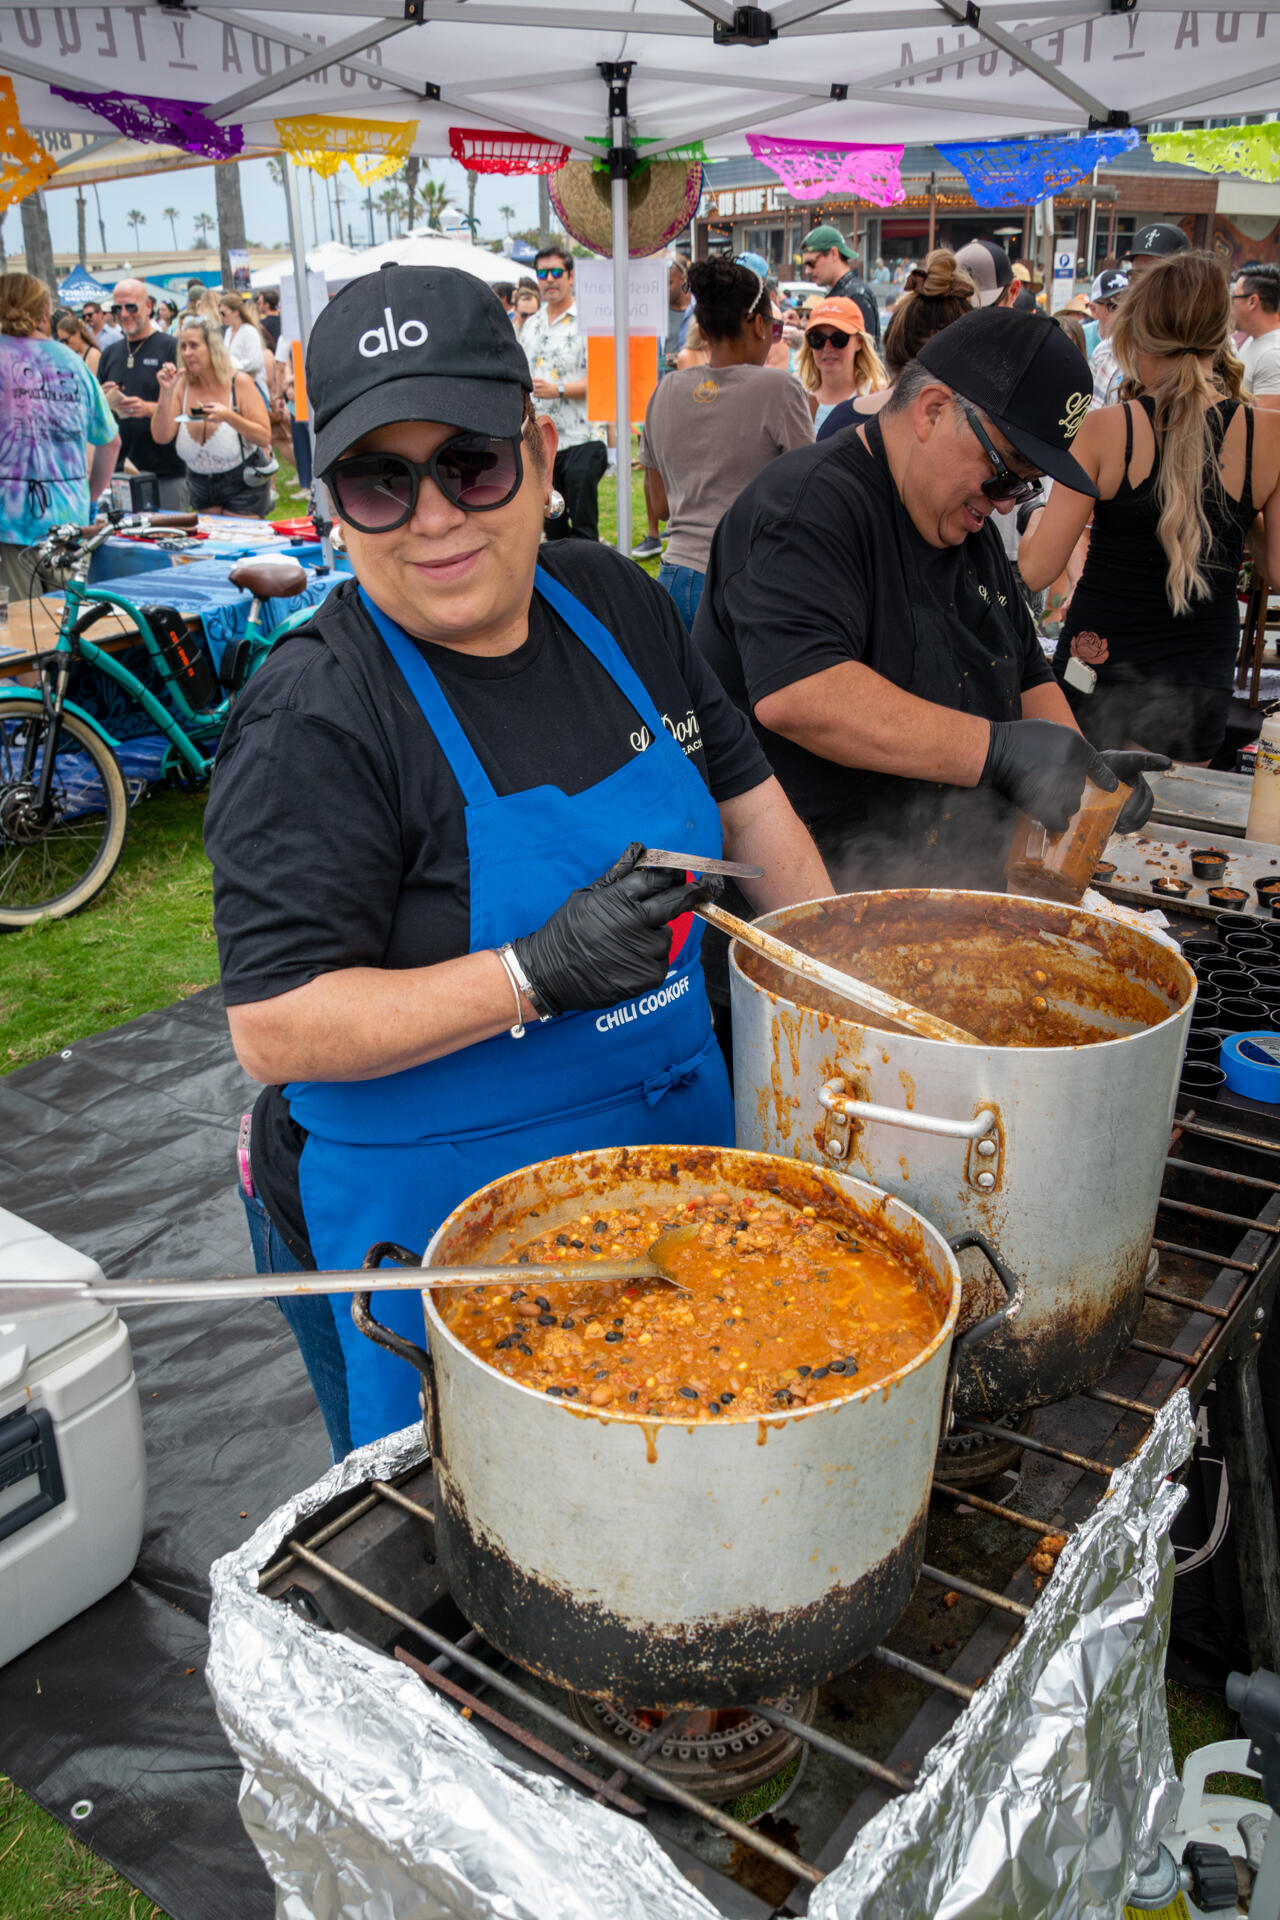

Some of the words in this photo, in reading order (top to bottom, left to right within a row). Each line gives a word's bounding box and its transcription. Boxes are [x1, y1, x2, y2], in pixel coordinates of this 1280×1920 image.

[358, 306, 429, 358] alo
[661, 710, 700, 742] Doñ
[681, 738, 704, 756] EACH
[595, 1003, 638, 1033] CHILI
[638, 975, 690, 1016] COOKOFF
